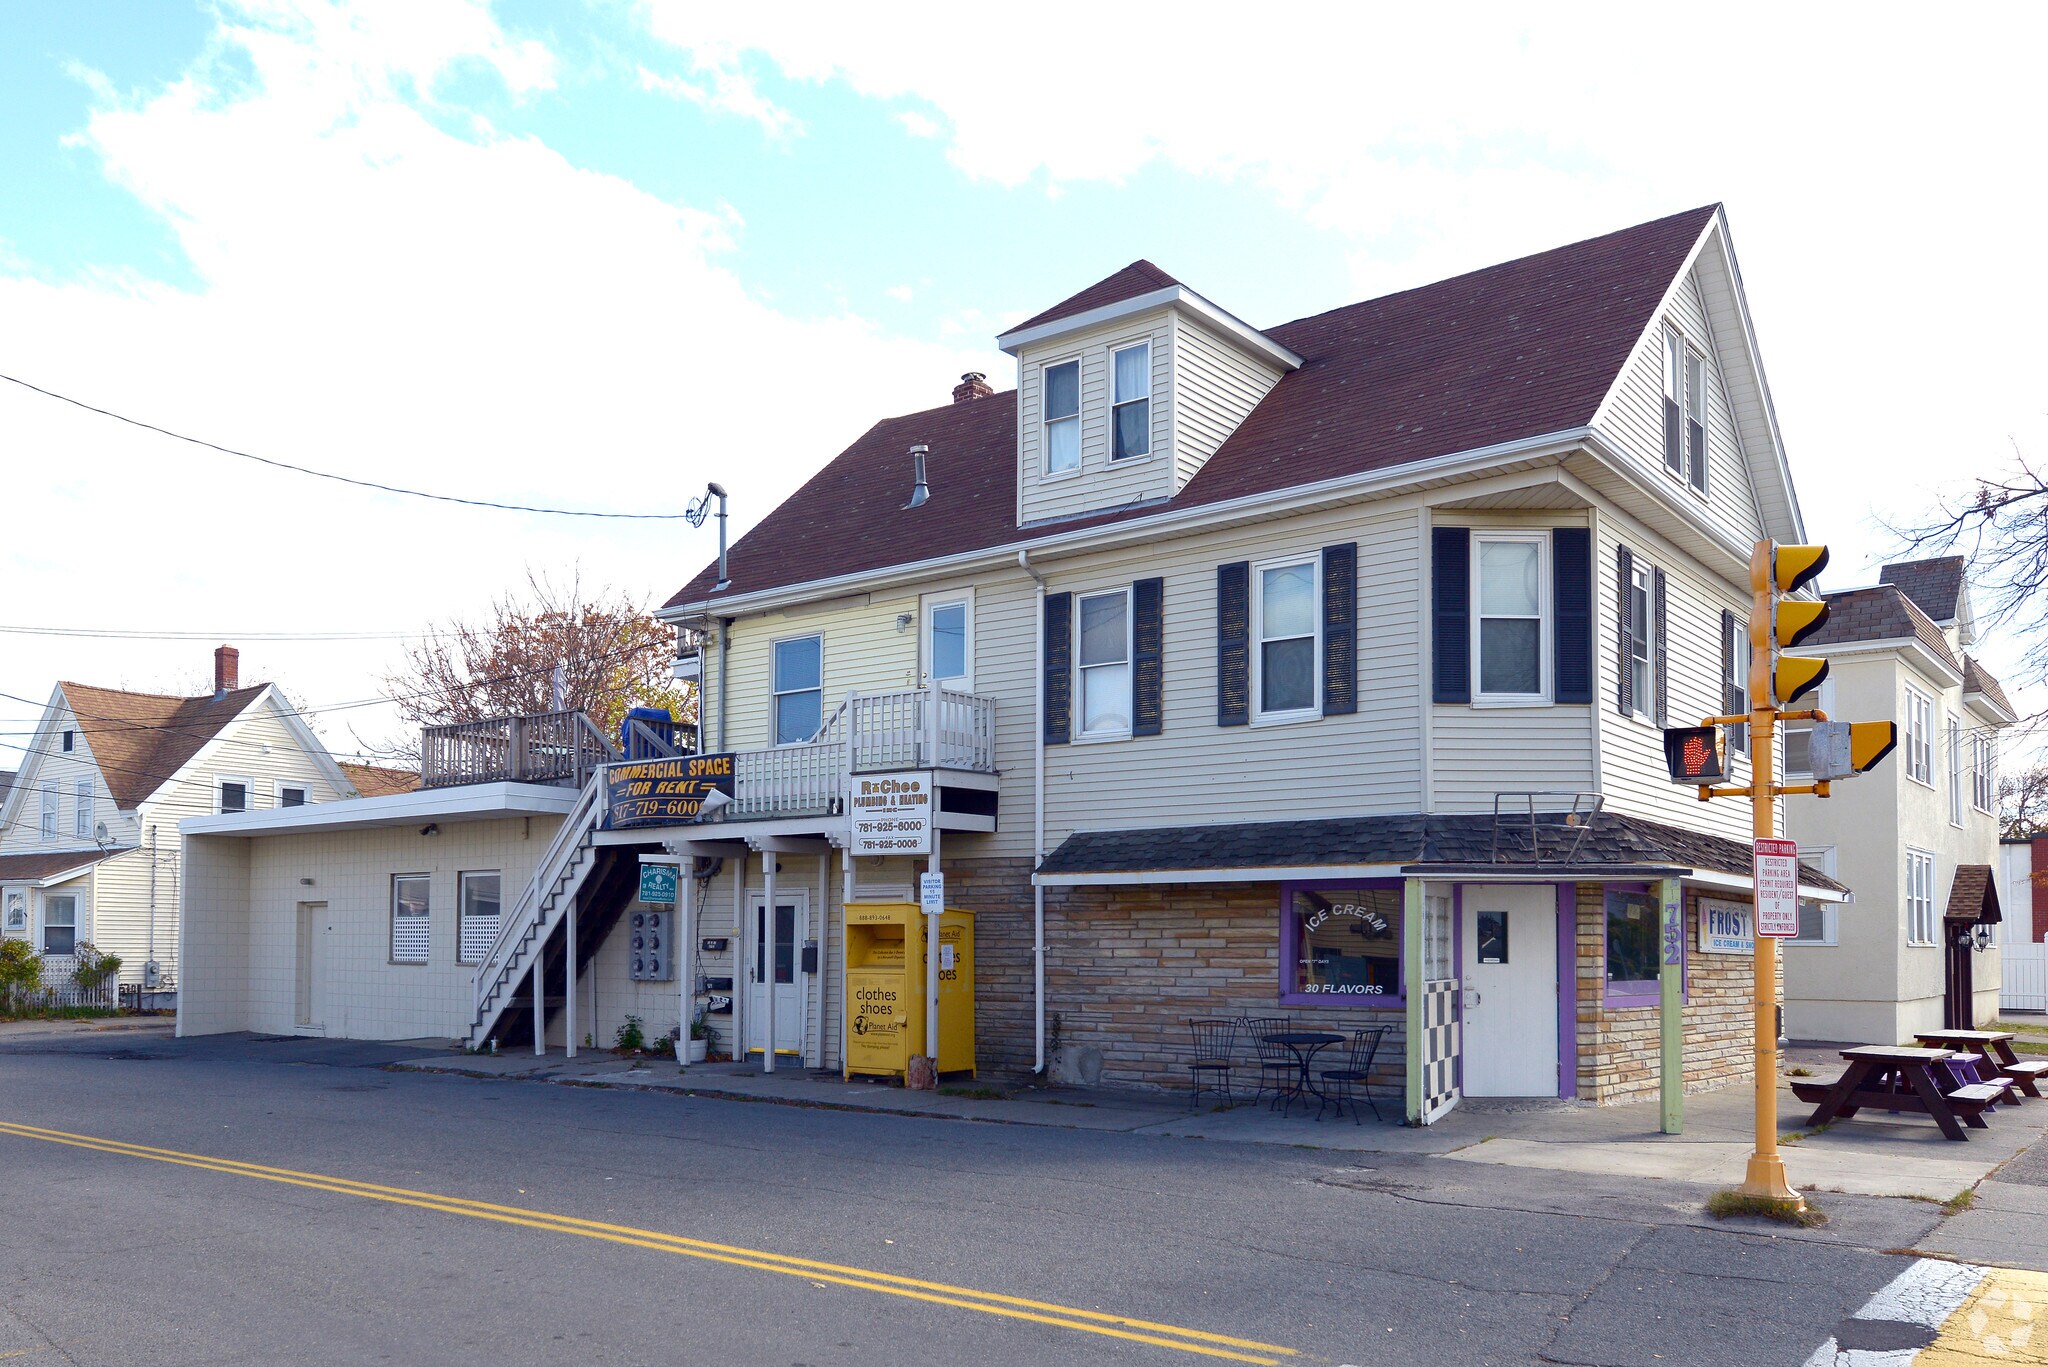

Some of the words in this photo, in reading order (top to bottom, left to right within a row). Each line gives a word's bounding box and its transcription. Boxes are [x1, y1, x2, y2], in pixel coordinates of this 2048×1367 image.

[609, 761, 684, 785] COMMERCIAL
[689, 757, 731, 777] SPACE
[625, 781, 652, 797] FOR
[655, 780, 700, 794] RENT
[854, 796, 887, 808] PLUMBING
[890, 795, 896, 806] &
[899, 793, 928, 806] HEATING
[858, 821, 922, 832] 781-925-6000
[863, 839, 918, 849] 781-925-0006
[1756, 842, 1778, 854] RESTRICTED
[1778, 843, 1795, 855] PARKING
[1765, 858, 1787, 867] RESTRICTED
[642, 867, 676, 881] CHARISMA
[1762, 869, 1779, 877] PARKING
[1780, 869, 1791, 878] AREA
[648, 881, 670, 891] REALTY
[1760, 879, 1773, 887] PERMIT
[1775, 880, 1793, 888] REQUIRED
[1305, 909, 1329, 932] ICE
[1332, 904, 1387, 931] CREAM
[1762, 912, 1781, 920] PROPERTY
[1782, 912, 1793, 920] ONLY
[1760, 922, 1776, 931] STRICTLY
[1777, 923, 1795, 931] ENFORCED
[952, 930, 961, 938] Aid
[1664, 903, 1681, 965] 752
[1713, 939, 1722, 947] ICE
[1723, 939, 1740, 948] CREAM
[938, 969, 957, 981] oes
[856, 986, 897, 1001] clothes
[1305, 984, 1319, 993] 30
[1322, 984, 1383, 994] FLAVORS
[860, 1001, 893, 1015] shoes
[868, 1021, 886, 1030] Planet
[887, 1023, 898, 1031] Aid
